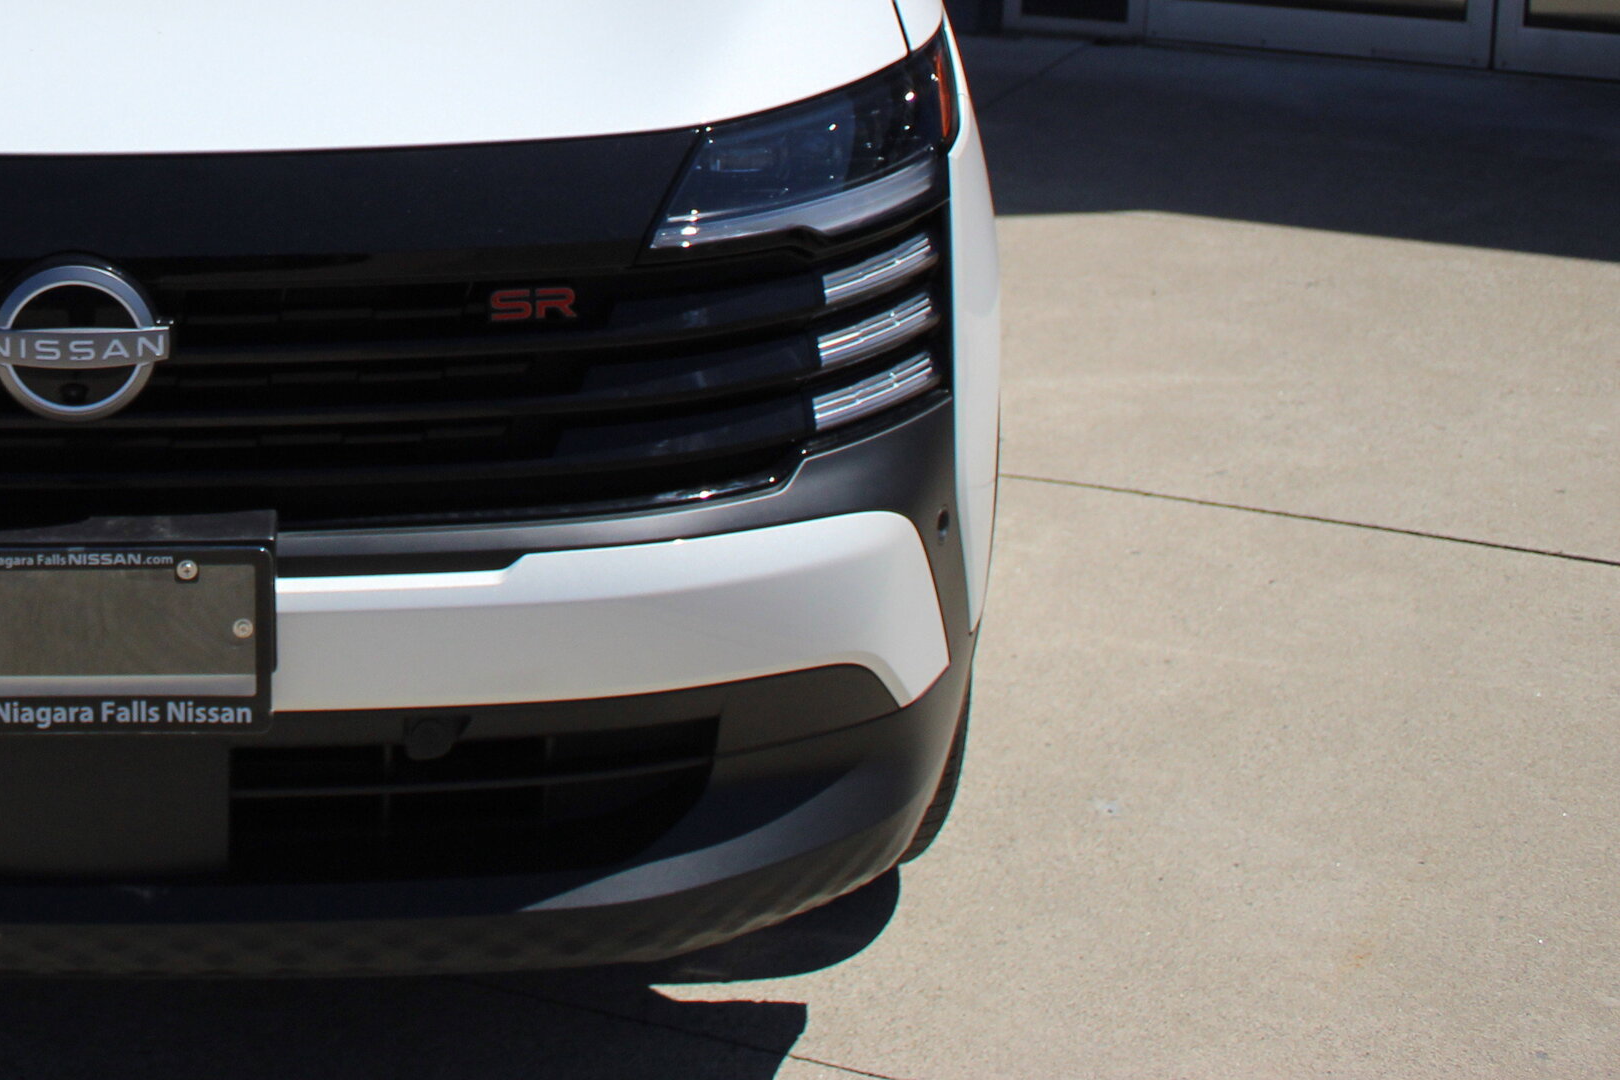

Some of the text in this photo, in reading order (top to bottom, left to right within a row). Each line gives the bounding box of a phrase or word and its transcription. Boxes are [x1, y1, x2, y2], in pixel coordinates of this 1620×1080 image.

[490, 288, 577, 320] SR
[36, 553, 67, 566] Falls
[100, 700, 161, 723] Falls
[166, 701, 253, 724] Nissan
